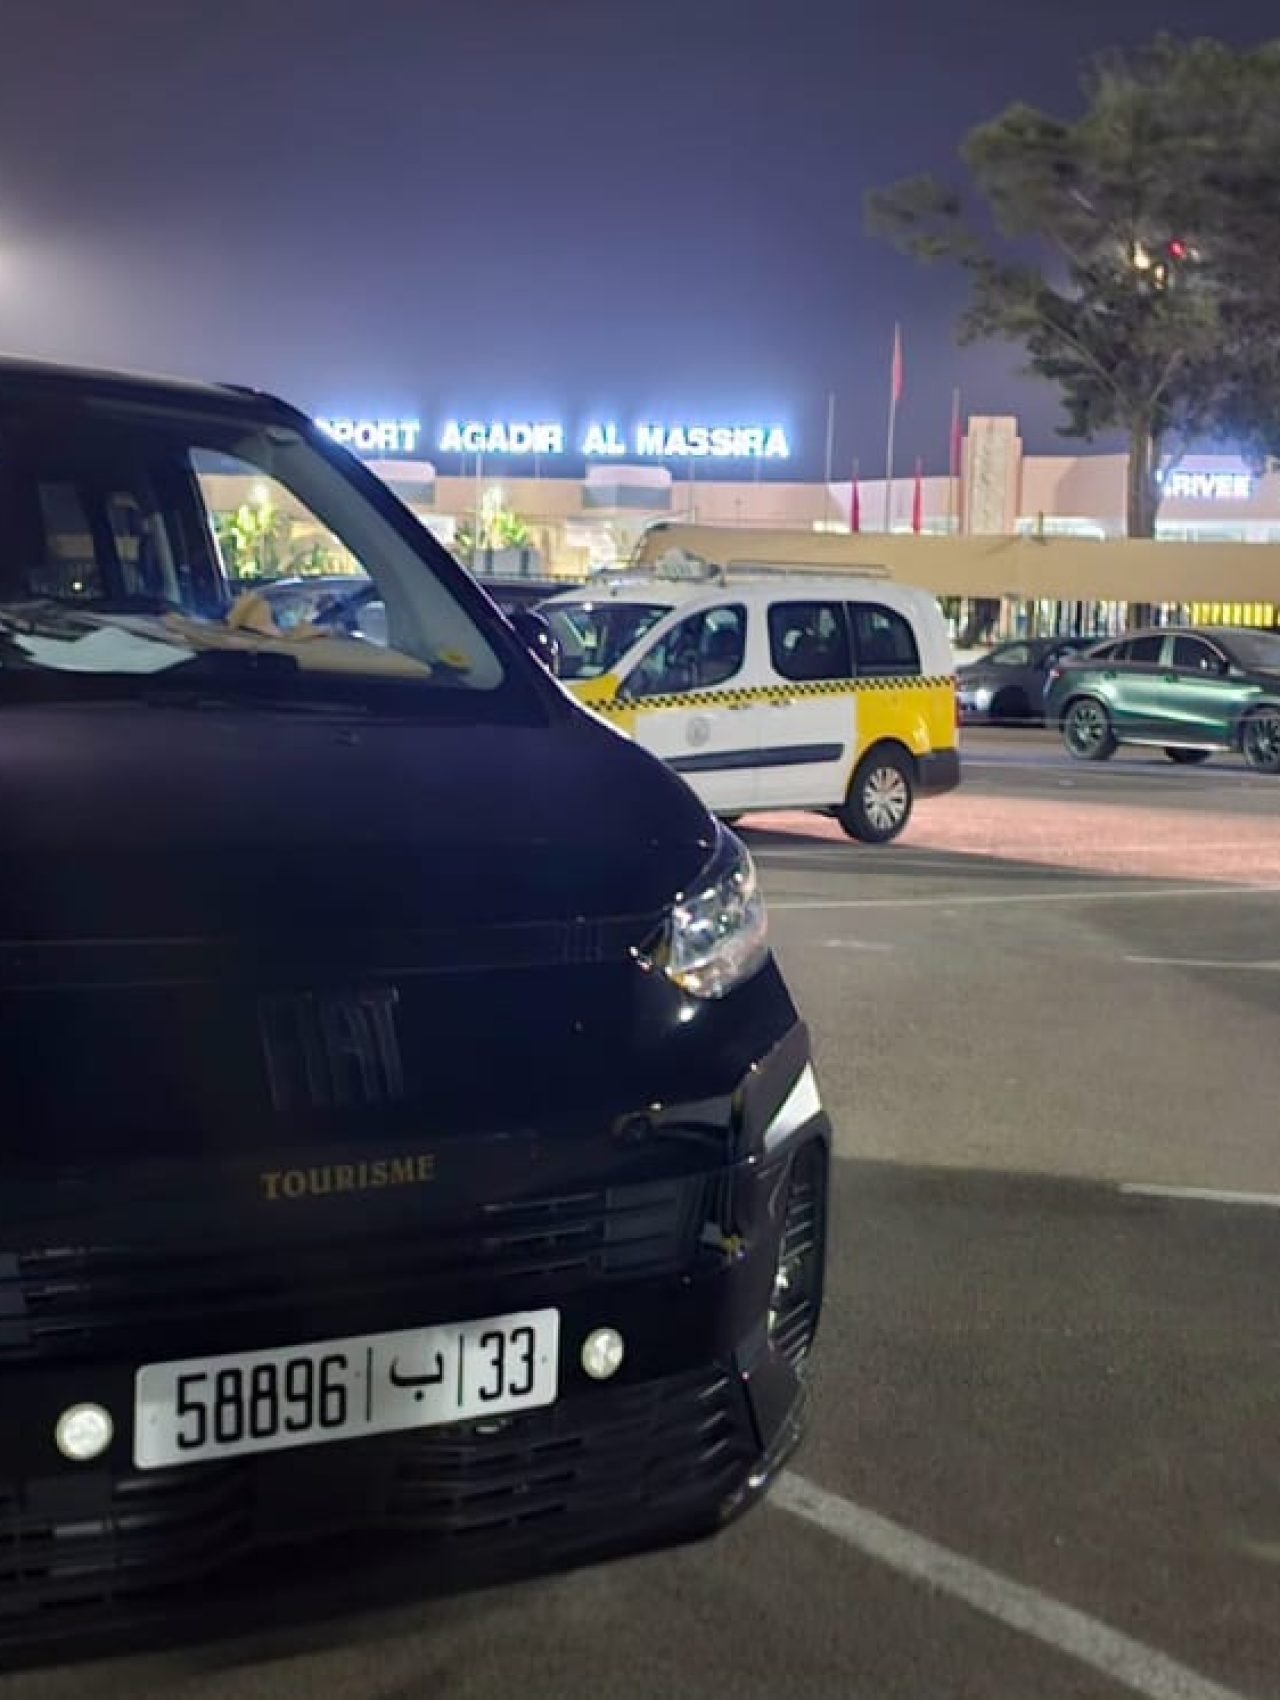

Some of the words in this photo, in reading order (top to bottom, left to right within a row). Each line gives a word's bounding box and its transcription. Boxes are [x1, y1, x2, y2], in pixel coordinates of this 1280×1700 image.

[439, 420, 564, 455] AGADIR
[583, 422, 626, 457] AL
[635, 425, 790, 459] MASSIRA
[260, 1153, 436, 1200] TOURISME
[176, 1354, 348, 1449] 58896
[389, 1352, 445, 1402] ب
[479, 1326, 535, 1402] 33
